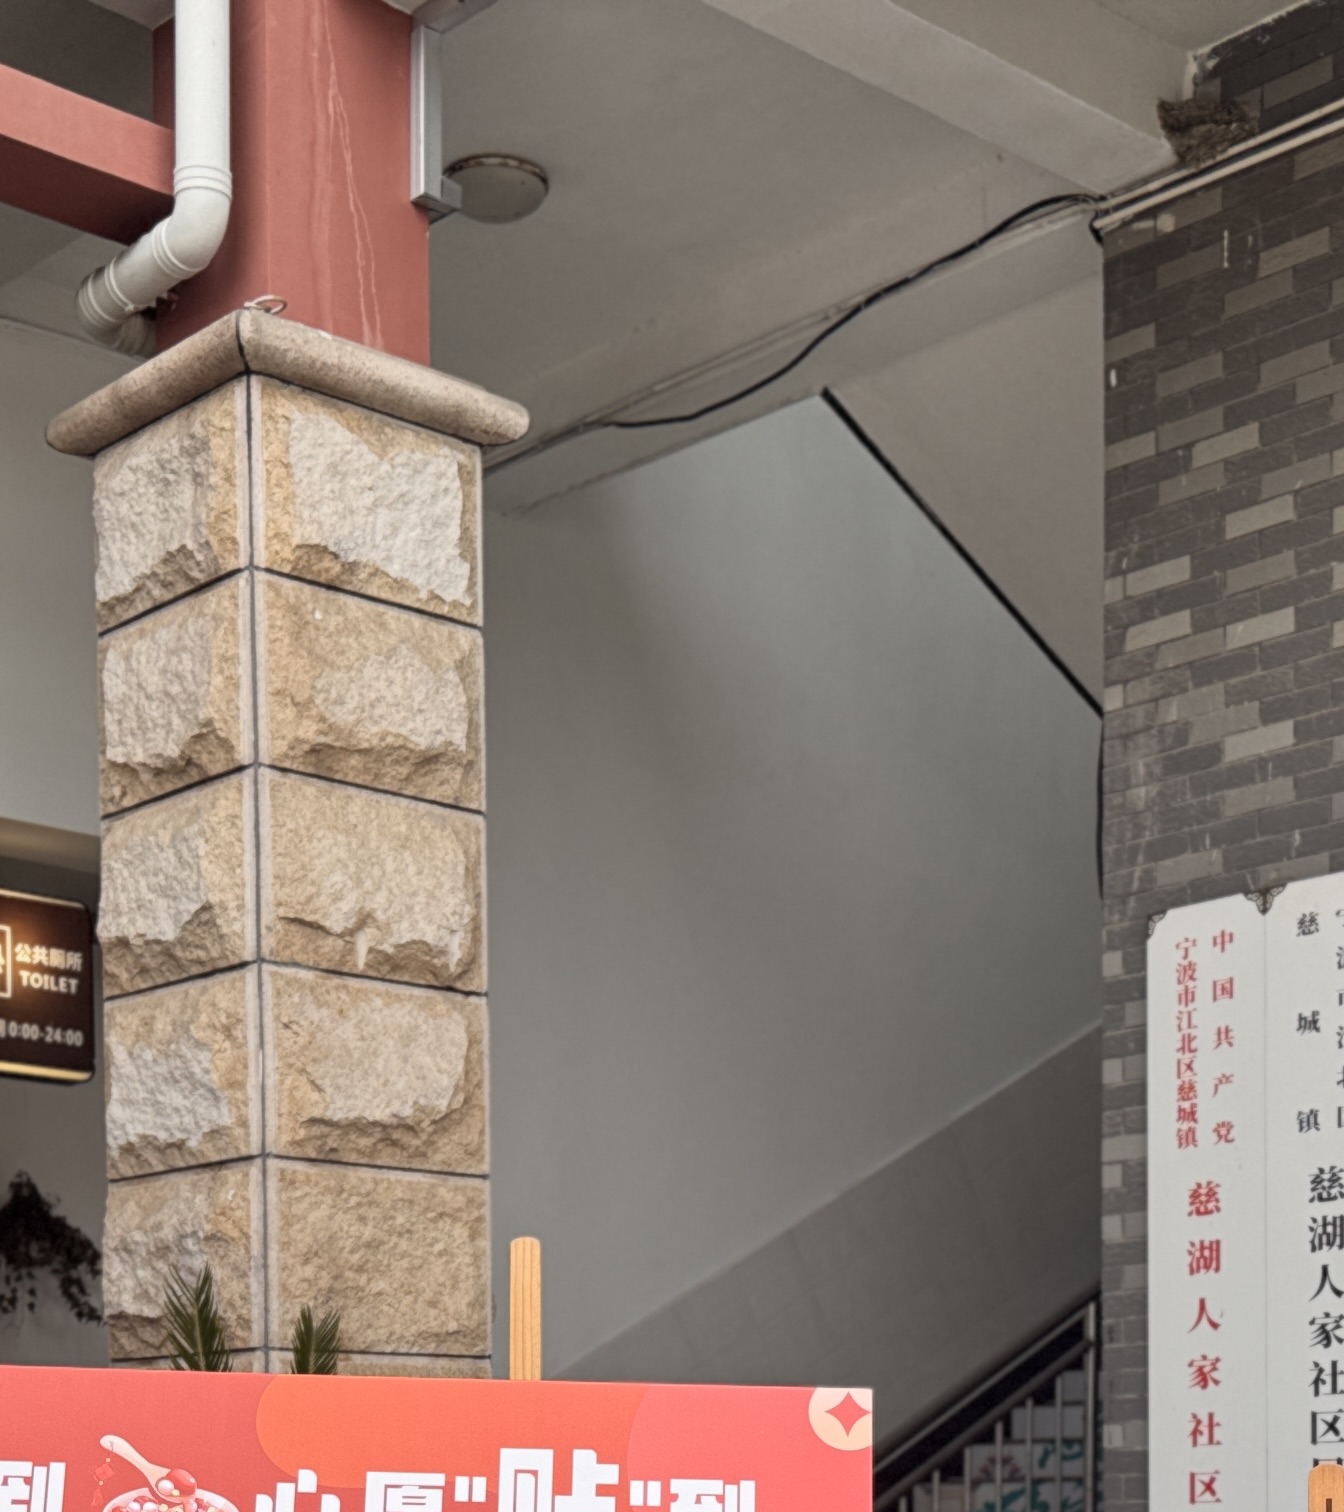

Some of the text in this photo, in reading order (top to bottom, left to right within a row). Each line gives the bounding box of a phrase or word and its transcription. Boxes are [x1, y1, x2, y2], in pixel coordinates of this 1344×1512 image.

[14, 942, 83, 972] 公共厕所
[18, 969, 80, 995] TOILET
[8, 1021, 84, 1047] 0:00-24:00
[1175, 935, 1199, 1150] 宁波市江北区慈城镇
[1211, 928, 1236, 1147] 中国共产党
[1295, 911, 1322, 1134] 慈城镇
